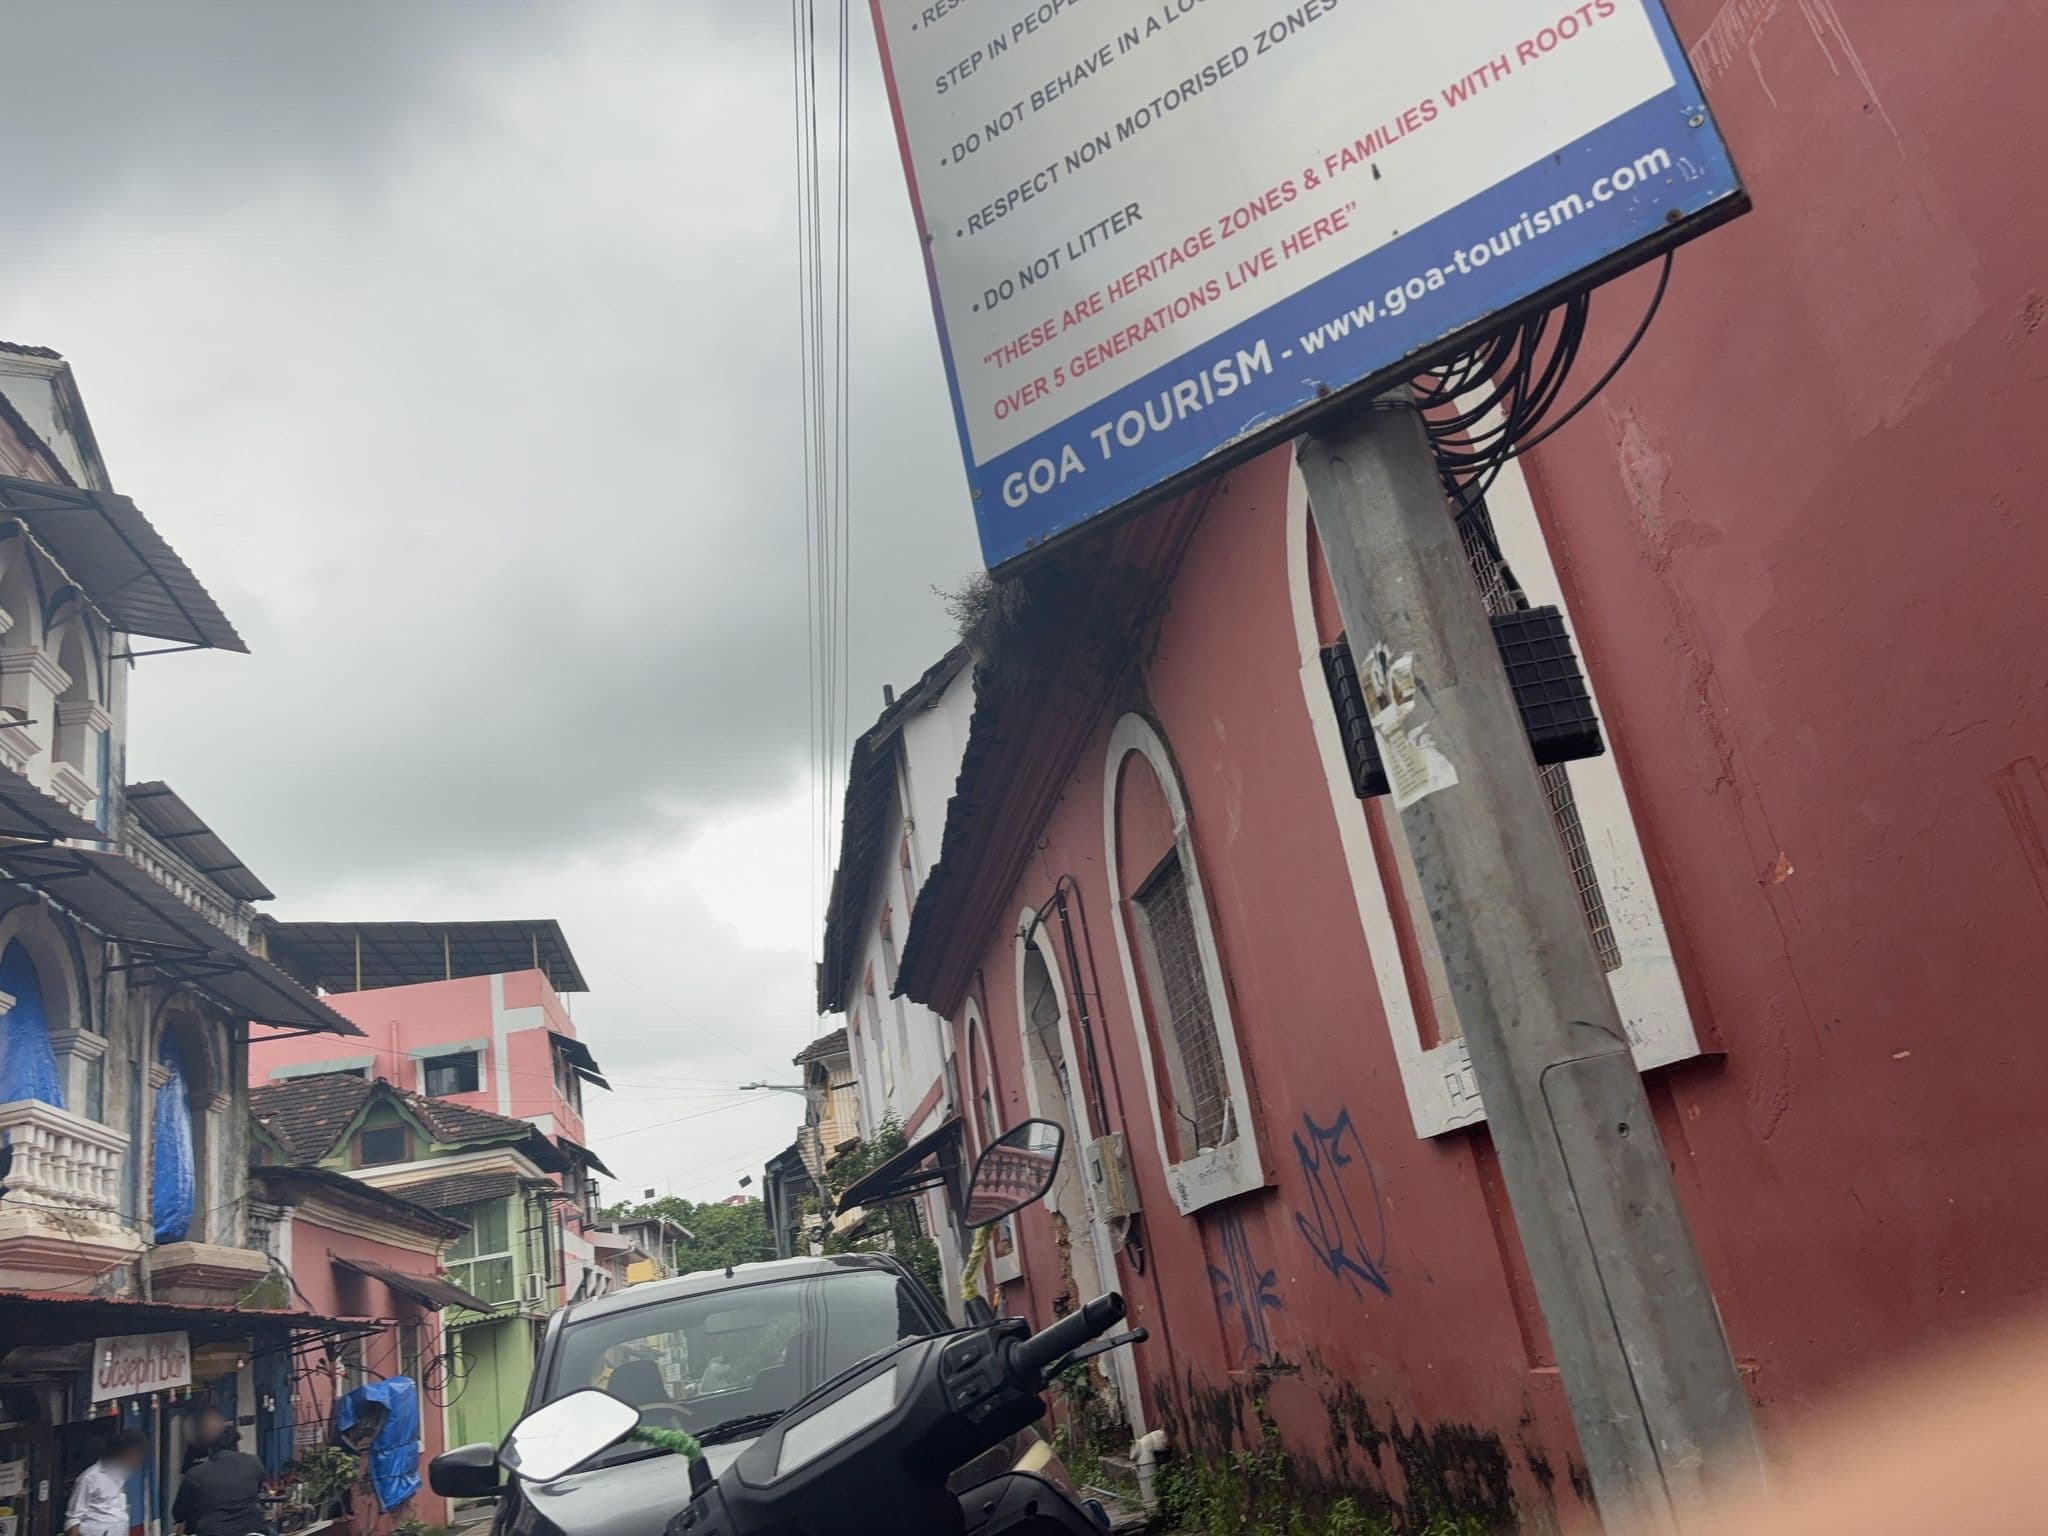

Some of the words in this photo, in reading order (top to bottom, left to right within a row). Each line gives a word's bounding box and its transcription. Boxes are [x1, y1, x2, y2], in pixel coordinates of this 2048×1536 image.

[922, 0, 965, 28] RES
[936, 51, 983, 95] STEP
[987, 34, 1008, 60] IN
[951, 133, 980, 163] DO
[984, 102, 1025, 142] NOT
[1030, 44, 1115, 112] BEHAVE
[1117, 27, 1140, 54] IN
[1145, 15, 1161, 38] A
[1164, 0, 1205, 24] LO
[967, 162, 1059, 235] RESPECT
[1064, 131, 1111, 174] NON
[1115, 45, 1249, 142] MOTORISED
[1253, 0, 1337, 55] ZONES
[1062, 291, 1104, 331] ARE
[1107, 226, 1216, 304] HERITAGE
[1218, 180, 1297, 240] ZONES
[1303, 168, 1321, 190] &
[1324, 99, 1438, 178] FAMILIES
[1441, 54, 1511, 108] WITH
[1516, 0, 1616, 66] ROOTS
[983, 279, 1014, 310] DO
[1018, 248, 1061, 290] NOT
[1066, 202, 1143, 261] LITTER
[993, 376, 1050, 421] OVER
[1053, 366, 1066, 388] 5
[1069, 279, 1221, 378] GENERATIONS
[1225, 247, 1278, 291] LIVE
[1002, 444, 1086, 509] GOA
[1090, 338, 1273, 461] TOURISM
[1299, 147, 1672, 355] www.goa-tourism.com
